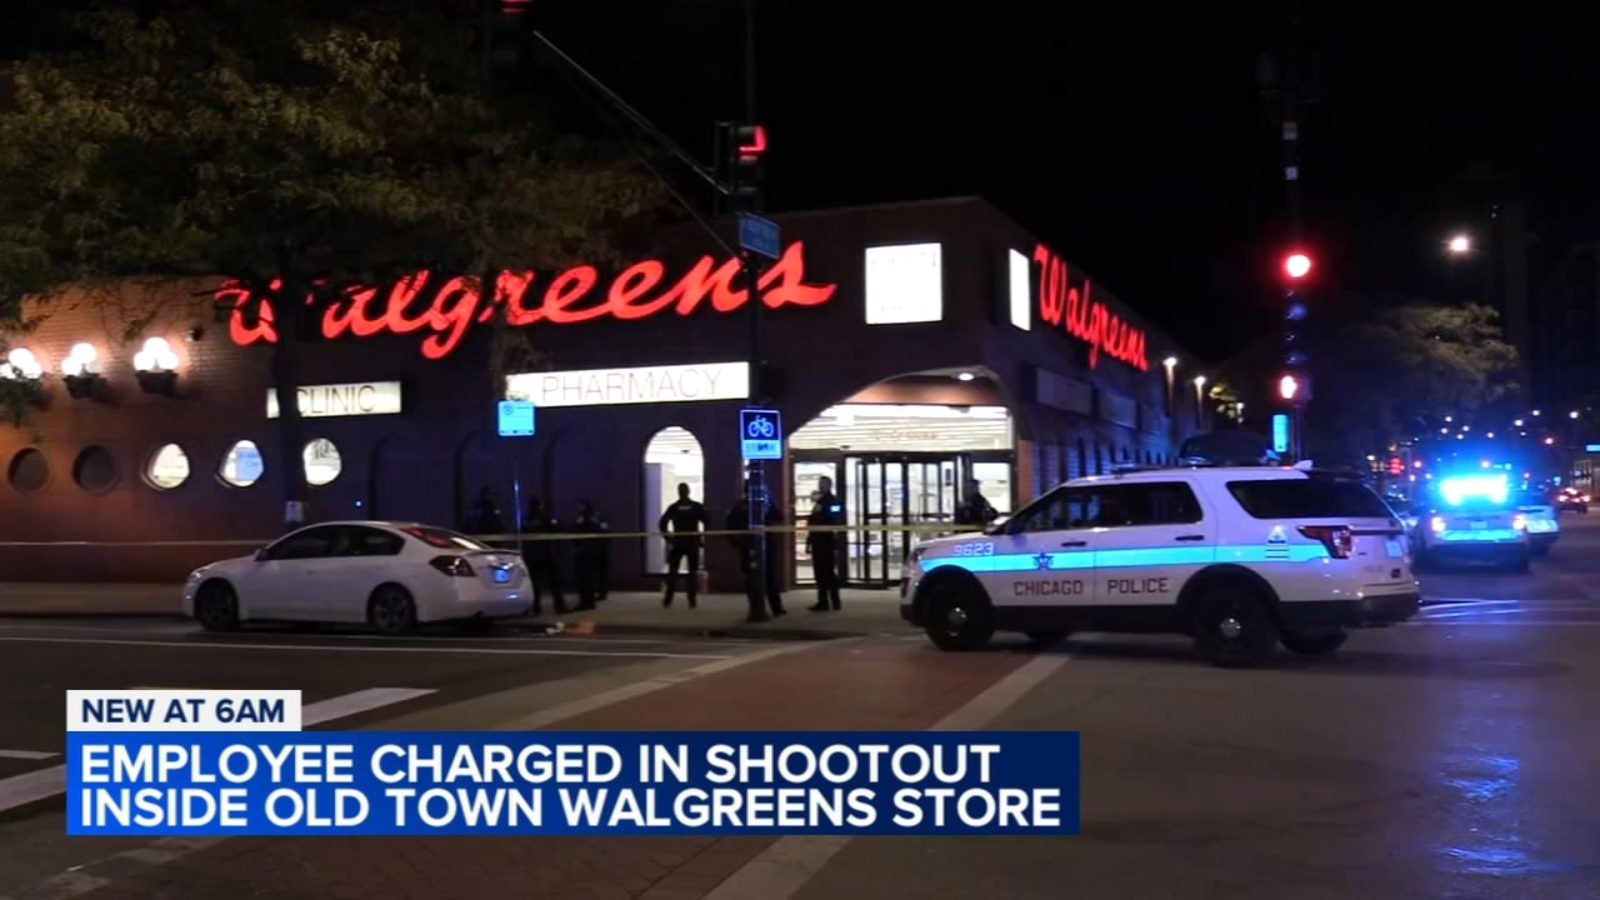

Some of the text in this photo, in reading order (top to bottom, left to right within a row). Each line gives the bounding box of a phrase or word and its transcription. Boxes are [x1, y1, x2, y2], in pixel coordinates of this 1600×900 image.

[1033, 243, 1150, 371] Walgreens
[541, 368, 723, 402] PHARMACY
[952, 541, 995, 557] 9623
[1013, 576, 1170, 597] CHICAGO POLICE
